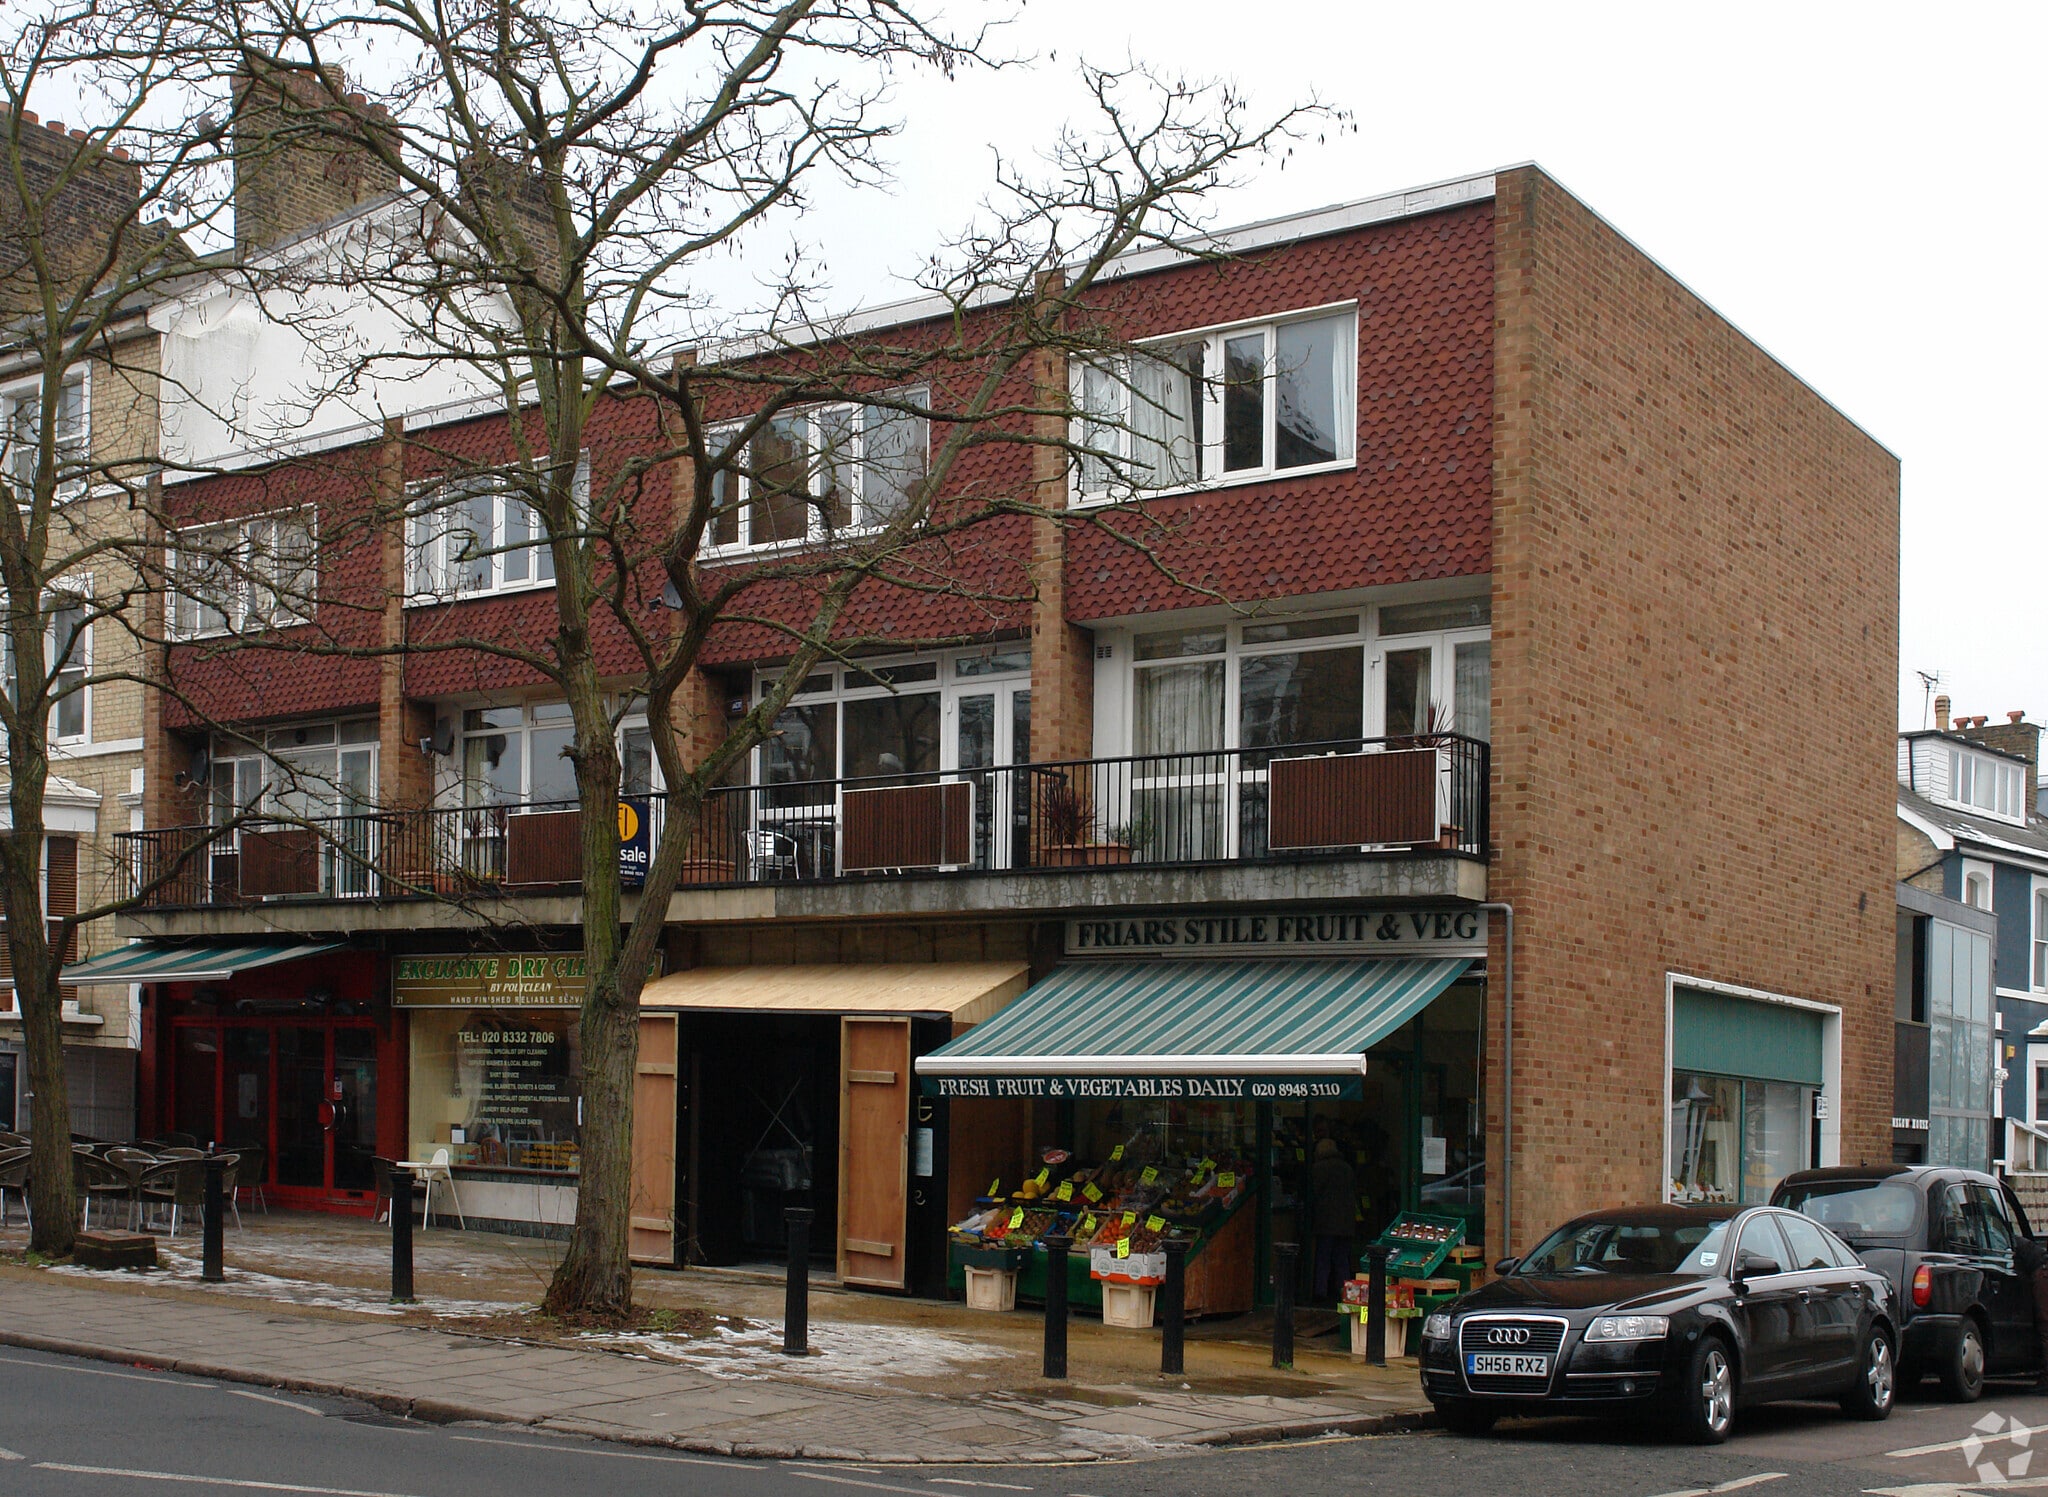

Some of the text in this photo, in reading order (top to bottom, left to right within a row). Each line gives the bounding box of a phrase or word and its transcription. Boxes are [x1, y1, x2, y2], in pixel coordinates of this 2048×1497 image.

[620, 846, 647, 863] sale
[1077, 911, 1478, 948] FRIARS STILE FRUIT & VEG
[397, 958, 500, 977] EXCLUSIVE
[505, 957, 549, 979] DRY
[489, 982, 553, 993] BY POLYCLEAN
[450, 996, 472, 1004] HAND
[514, 996, 554, 1004] RELIABLE
[558, 995, 585, 1004] SERVI
[458, 1031, 555, 1044] TEL: 020 8332 7806
[937, 1078, 1341, 1098] FRESH FRUIT & VEGETABLES DAILY 020 8948 3110
[1476, 1357, 1544, 1373] SH56 RXZ
